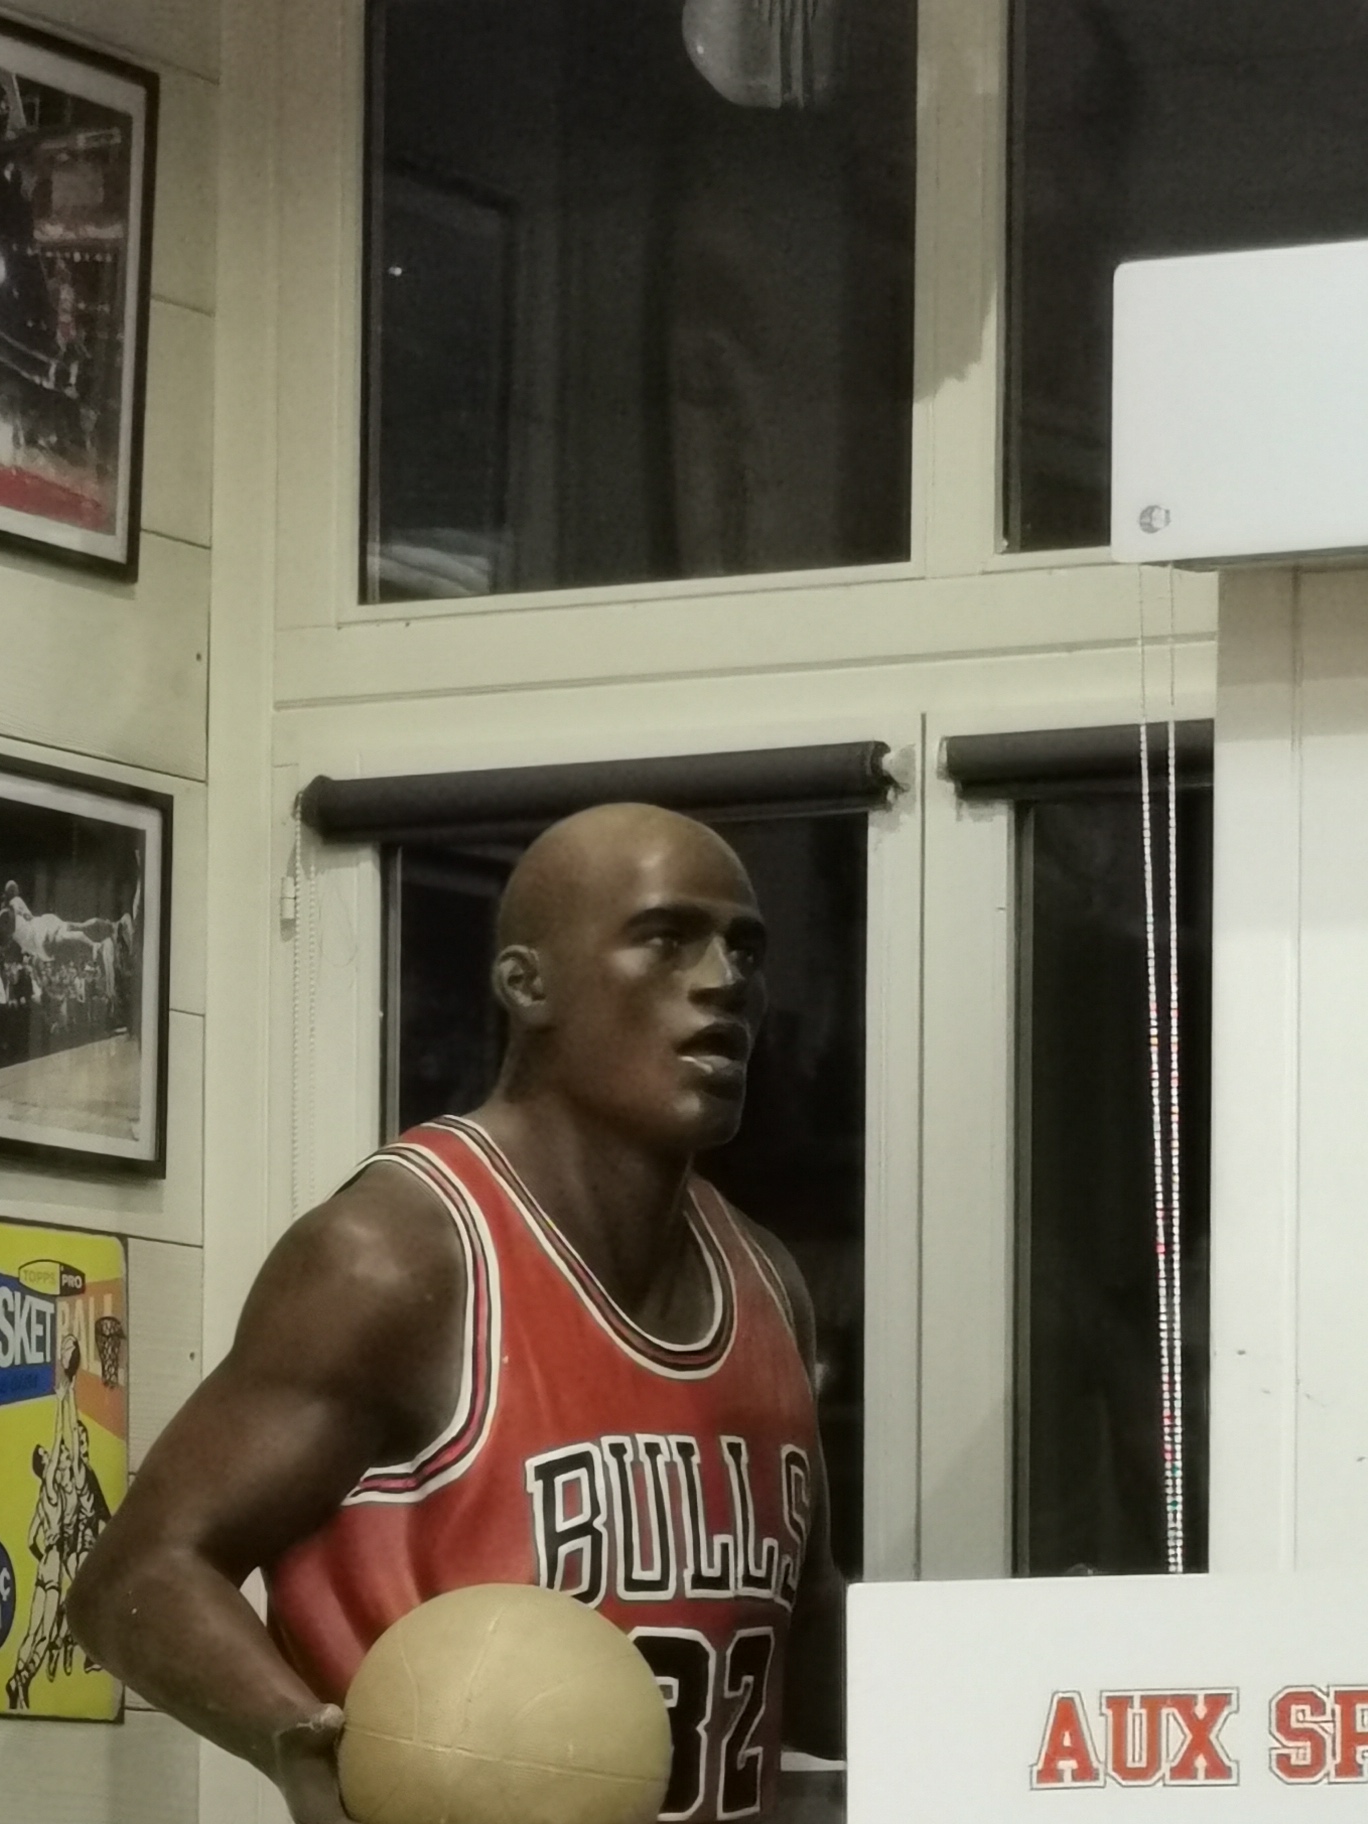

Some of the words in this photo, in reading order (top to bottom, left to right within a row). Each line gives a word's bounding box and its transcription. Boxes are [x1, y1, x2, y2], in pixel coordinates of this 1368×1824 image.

[23, 1268, 56, 1286] TOPPS
[61, 1273, 83, 1290] PRO
[525, 1433, 811, 1613] BULLS
[1029, 1686, 1240, 1791] AUX
